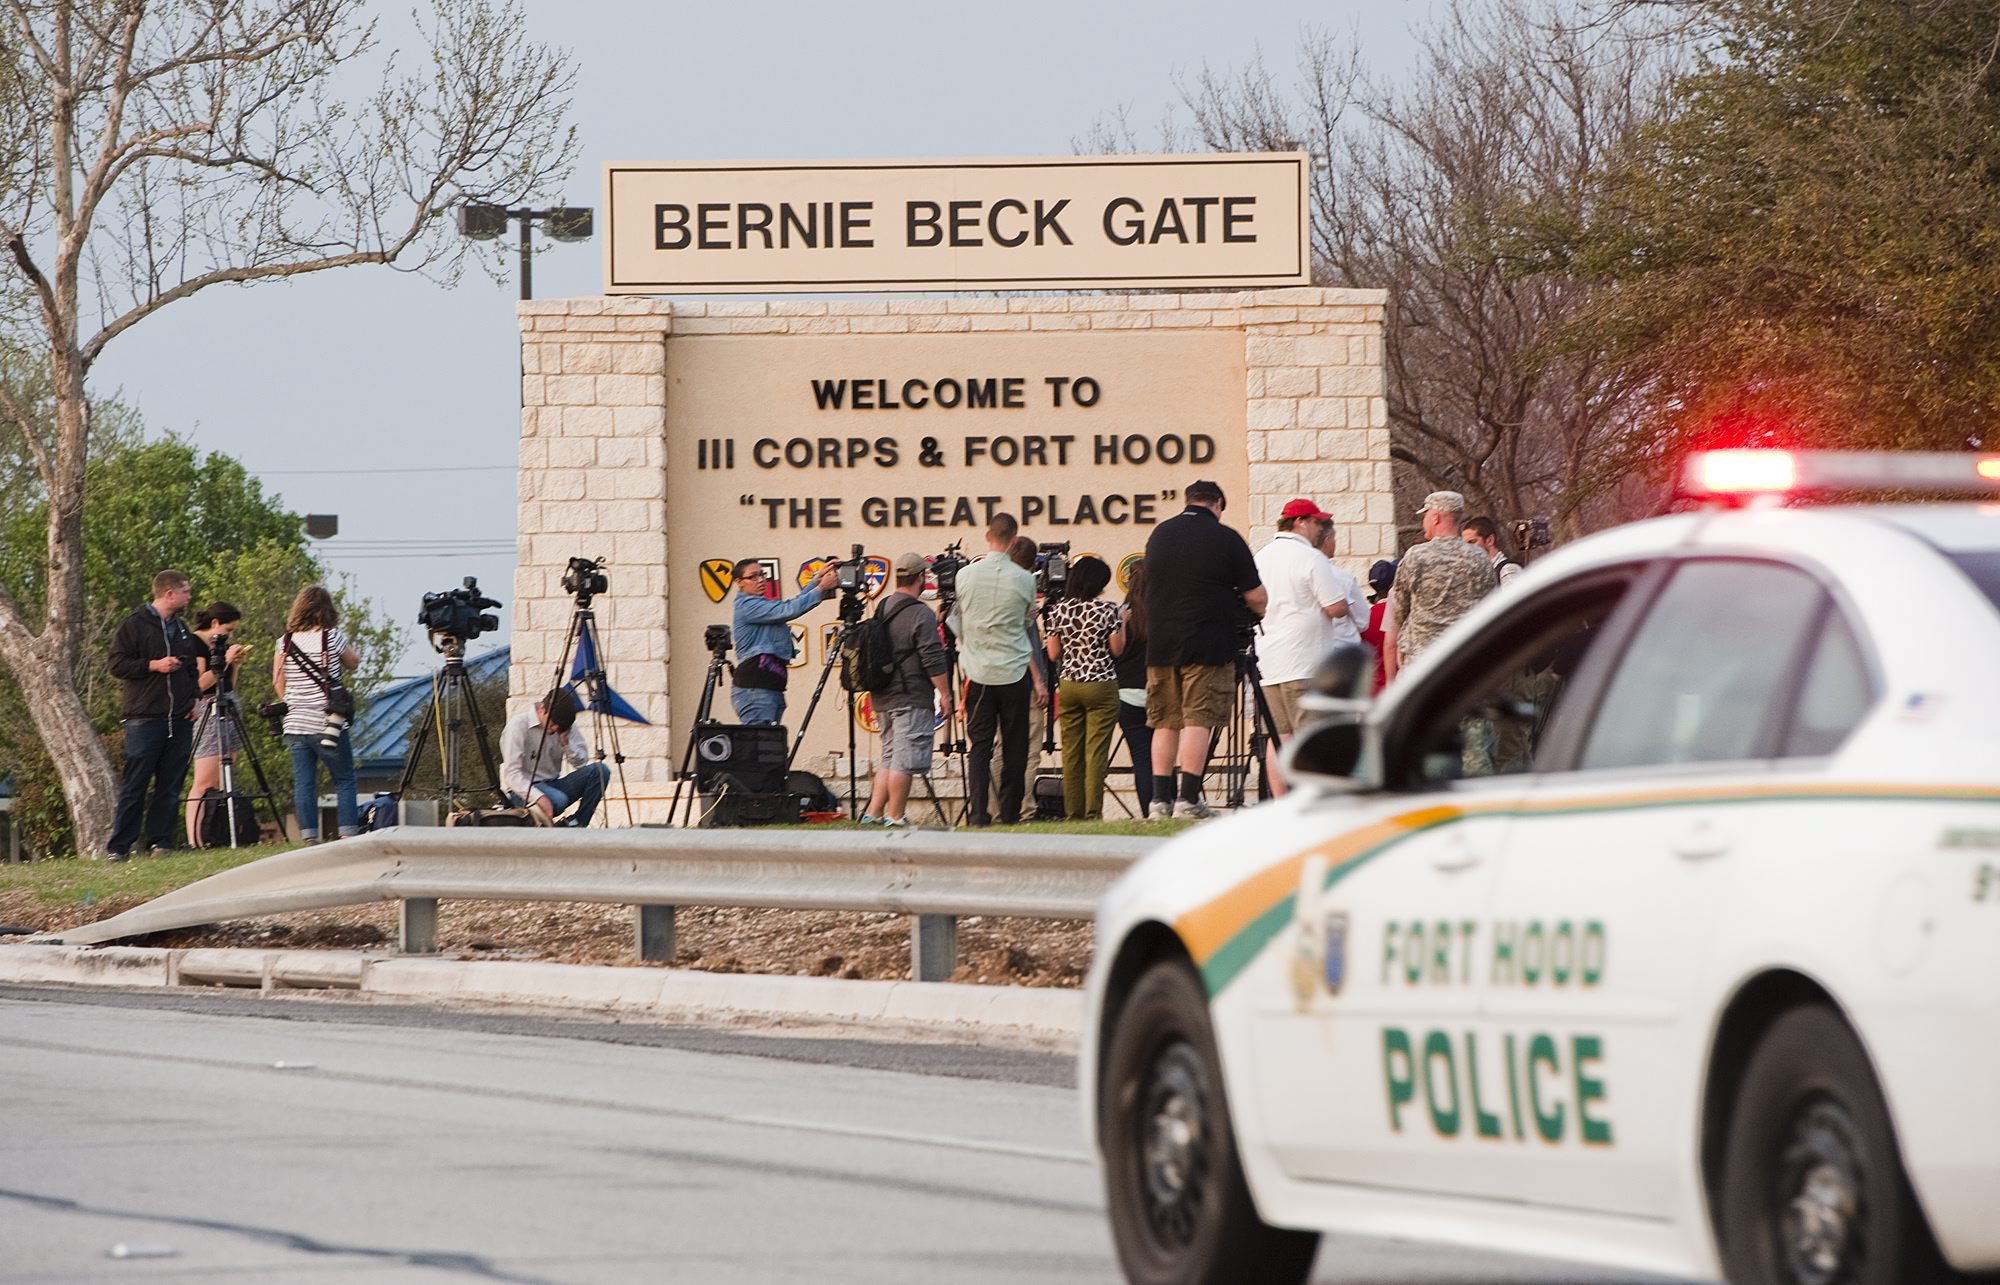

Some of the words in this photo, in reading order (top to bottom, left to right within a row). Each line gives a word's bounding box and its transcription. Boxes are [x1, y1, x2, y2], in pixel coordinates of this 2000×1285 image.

[655, 202, 874, 250] BERNIE
[906, 199, 1073, 248] BECK
[1103, 196, 1257, 246] GATE
[811, 377, 1025, 411] WELCOME
[1044, 376, 1101, 408] TO
[697, 438, 734, 471] III
[752, 437, 899, 470] CORPS
[918, 436, 945, 468] &
[964, 435, 1075, 467] FORT
[1094, 433, 1216, 466] HOOD
[861, 496, 1002, 528] GREAT
[1381, 919, 1478, 987] FORT
[1489, 920, 1607, 988] HOOD
[1382, 1026, 1616, 1146] POLICE
